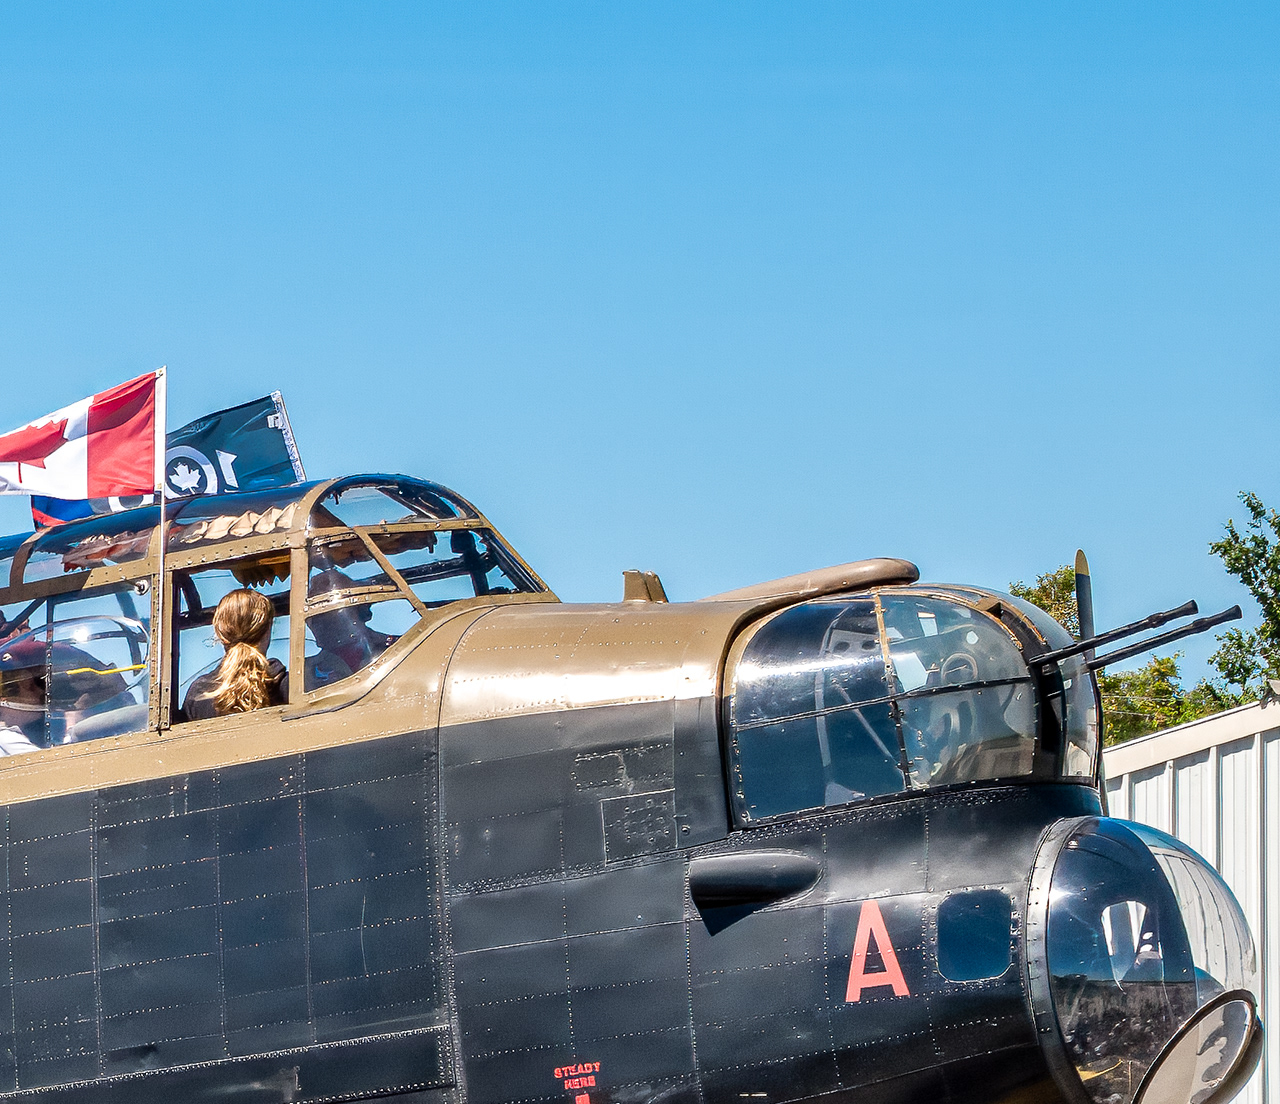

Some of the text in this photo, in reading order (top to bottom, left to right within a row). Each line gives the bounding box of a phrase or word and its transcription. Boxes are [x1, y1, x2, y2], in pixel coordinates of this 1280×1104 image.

[845, 899, 911, 1002] A
[553, 1061, 601, 1079] STEADY
[563, 1075, 596, 1090] HERE
